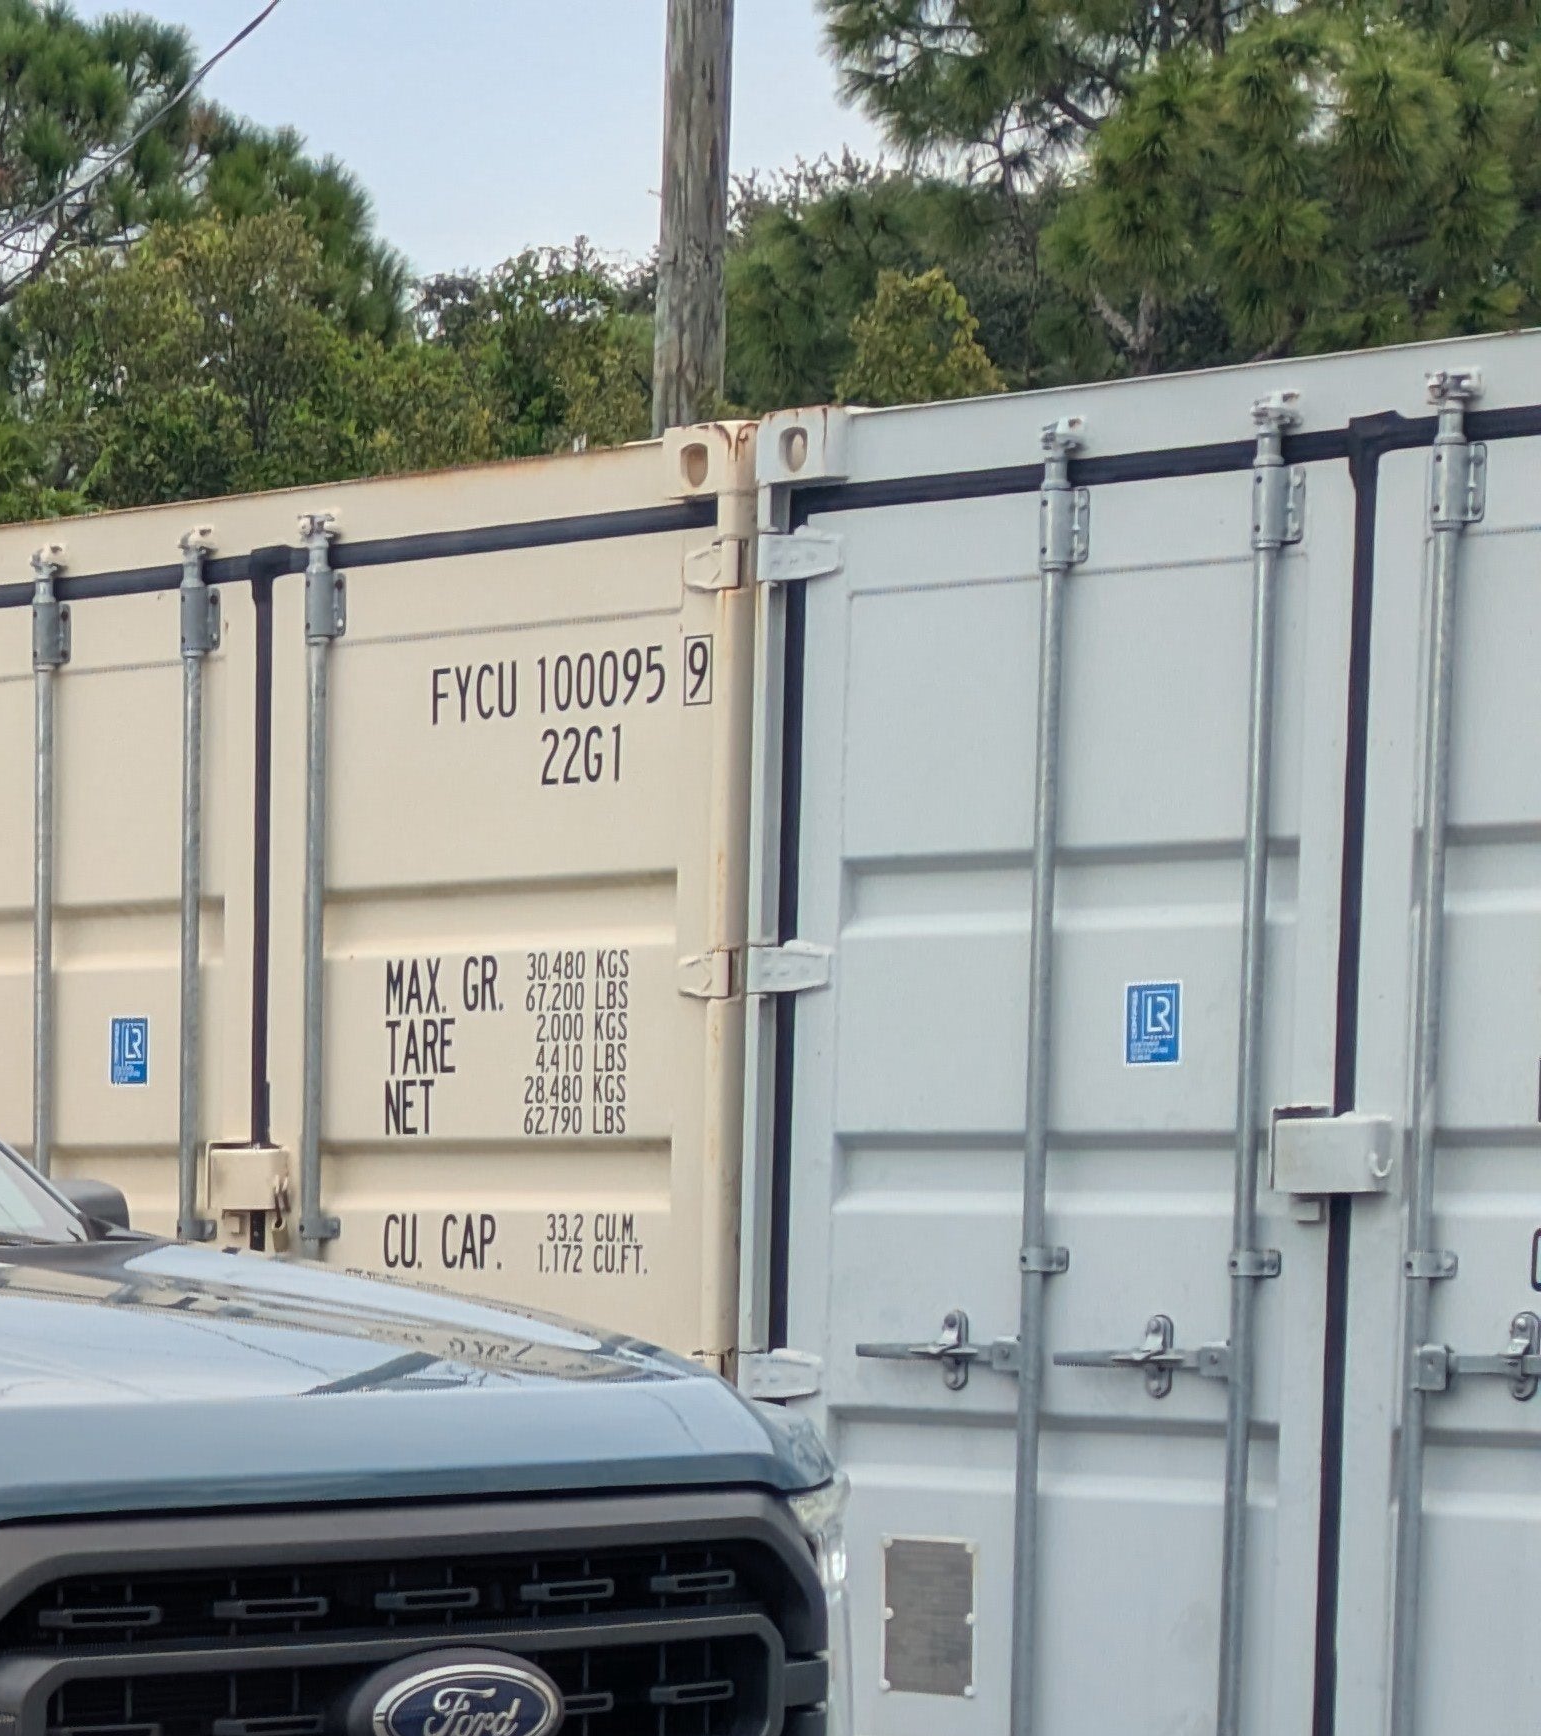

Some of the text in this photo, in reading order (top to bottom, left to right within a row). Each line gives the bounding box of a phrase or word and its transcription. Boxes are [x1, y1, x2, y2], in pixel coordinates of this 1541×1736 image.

[432, 640, 709, 725] FYCU 100095 9
[540, 723, 622, 786] 22G1
[596, 949, 629, 979] KGS
[385, 955, 504, 1016] MAX. GR.
[595, 980, 629, 1010] LBS
[594, 1011, 628, 1041] KGS
[1146, 995, 1171, 1033] LR
[124, 1027, 142, 1059] LR
[385, 1017, 456, 1076] TARE
[593, 1042, 627, 1072] LBS
[593, 1073, 626, 1103] KGS
[384, 1079, 435, 1136] NET
[592, 1104, 626, 1134] LBS
[383, 1213, 503, 1270] CU. CAP.
[546, 1213, 584, 1242] 33.2
